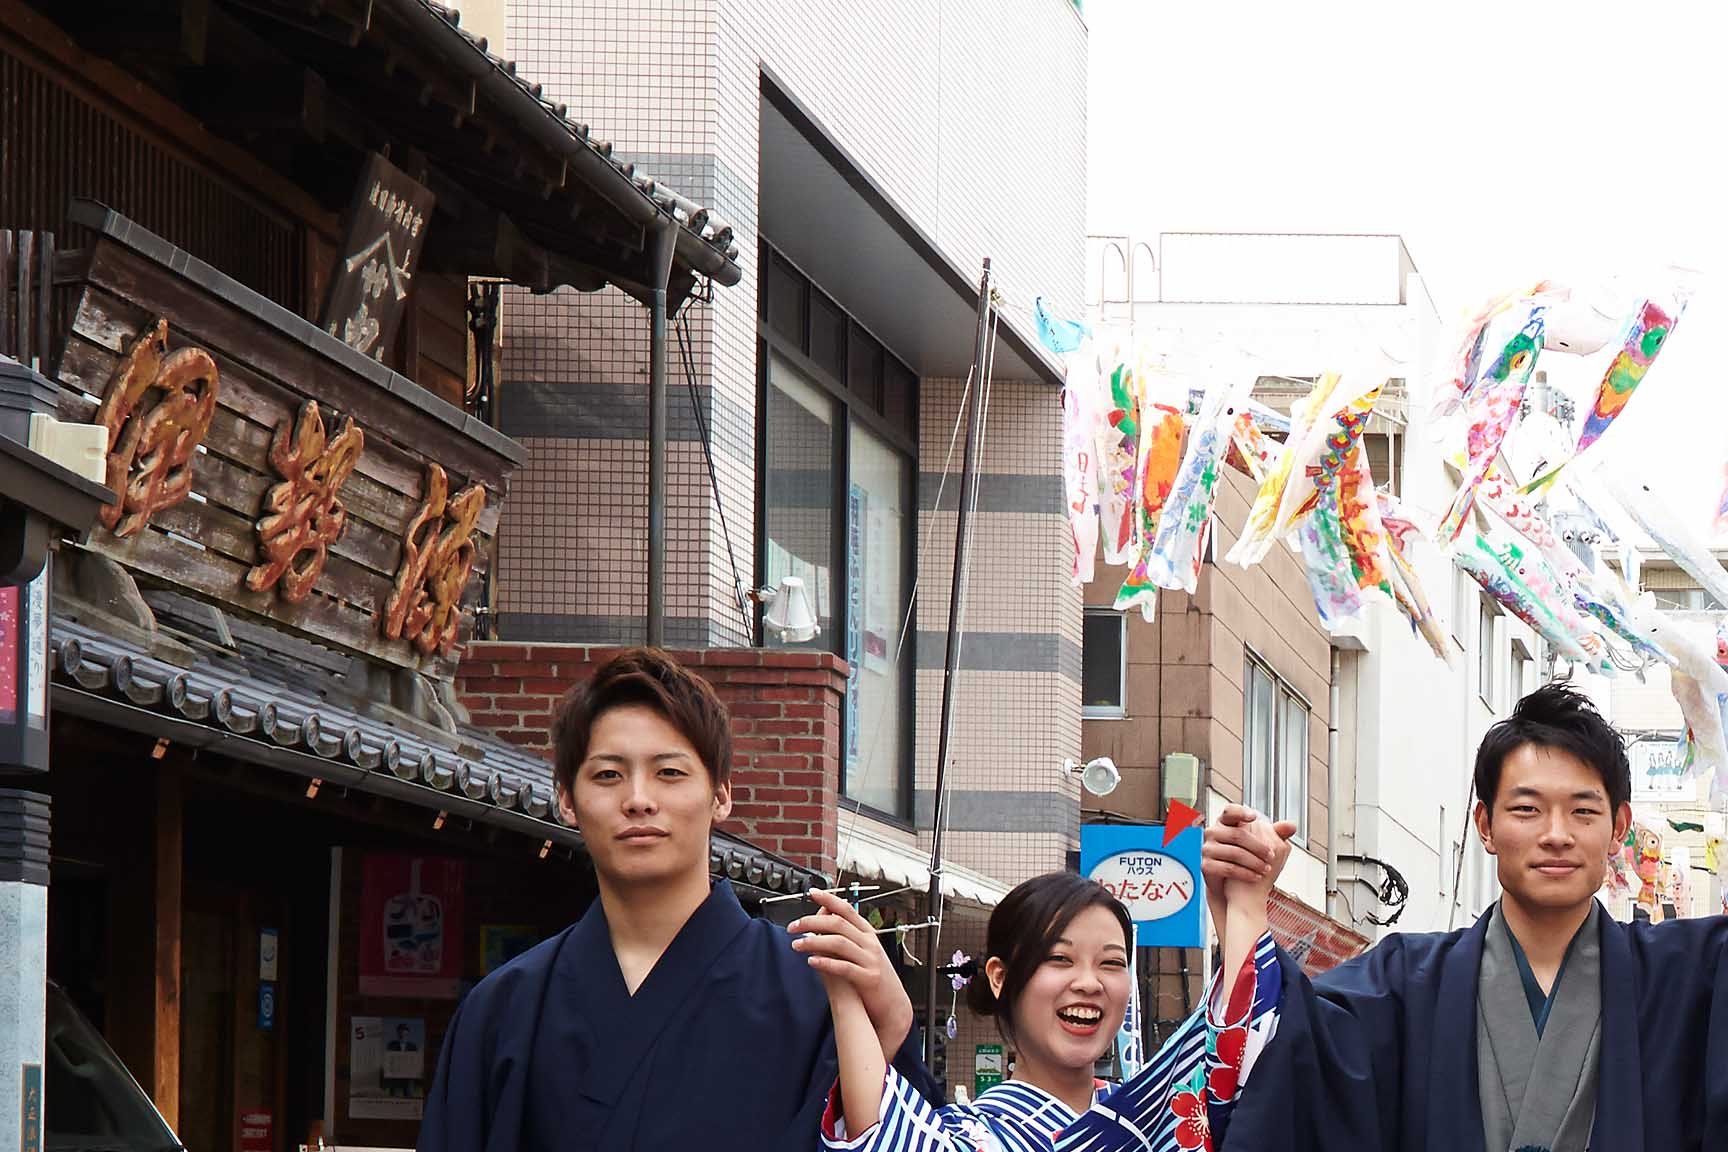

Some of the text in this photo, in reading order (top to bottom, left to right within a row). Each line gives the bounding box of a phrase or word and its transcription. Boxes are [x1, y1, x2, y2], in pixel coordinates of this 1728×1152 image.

[1119, 856, 1162, 866] FUTON
[1127, 866, 1154, 876] ハウス
